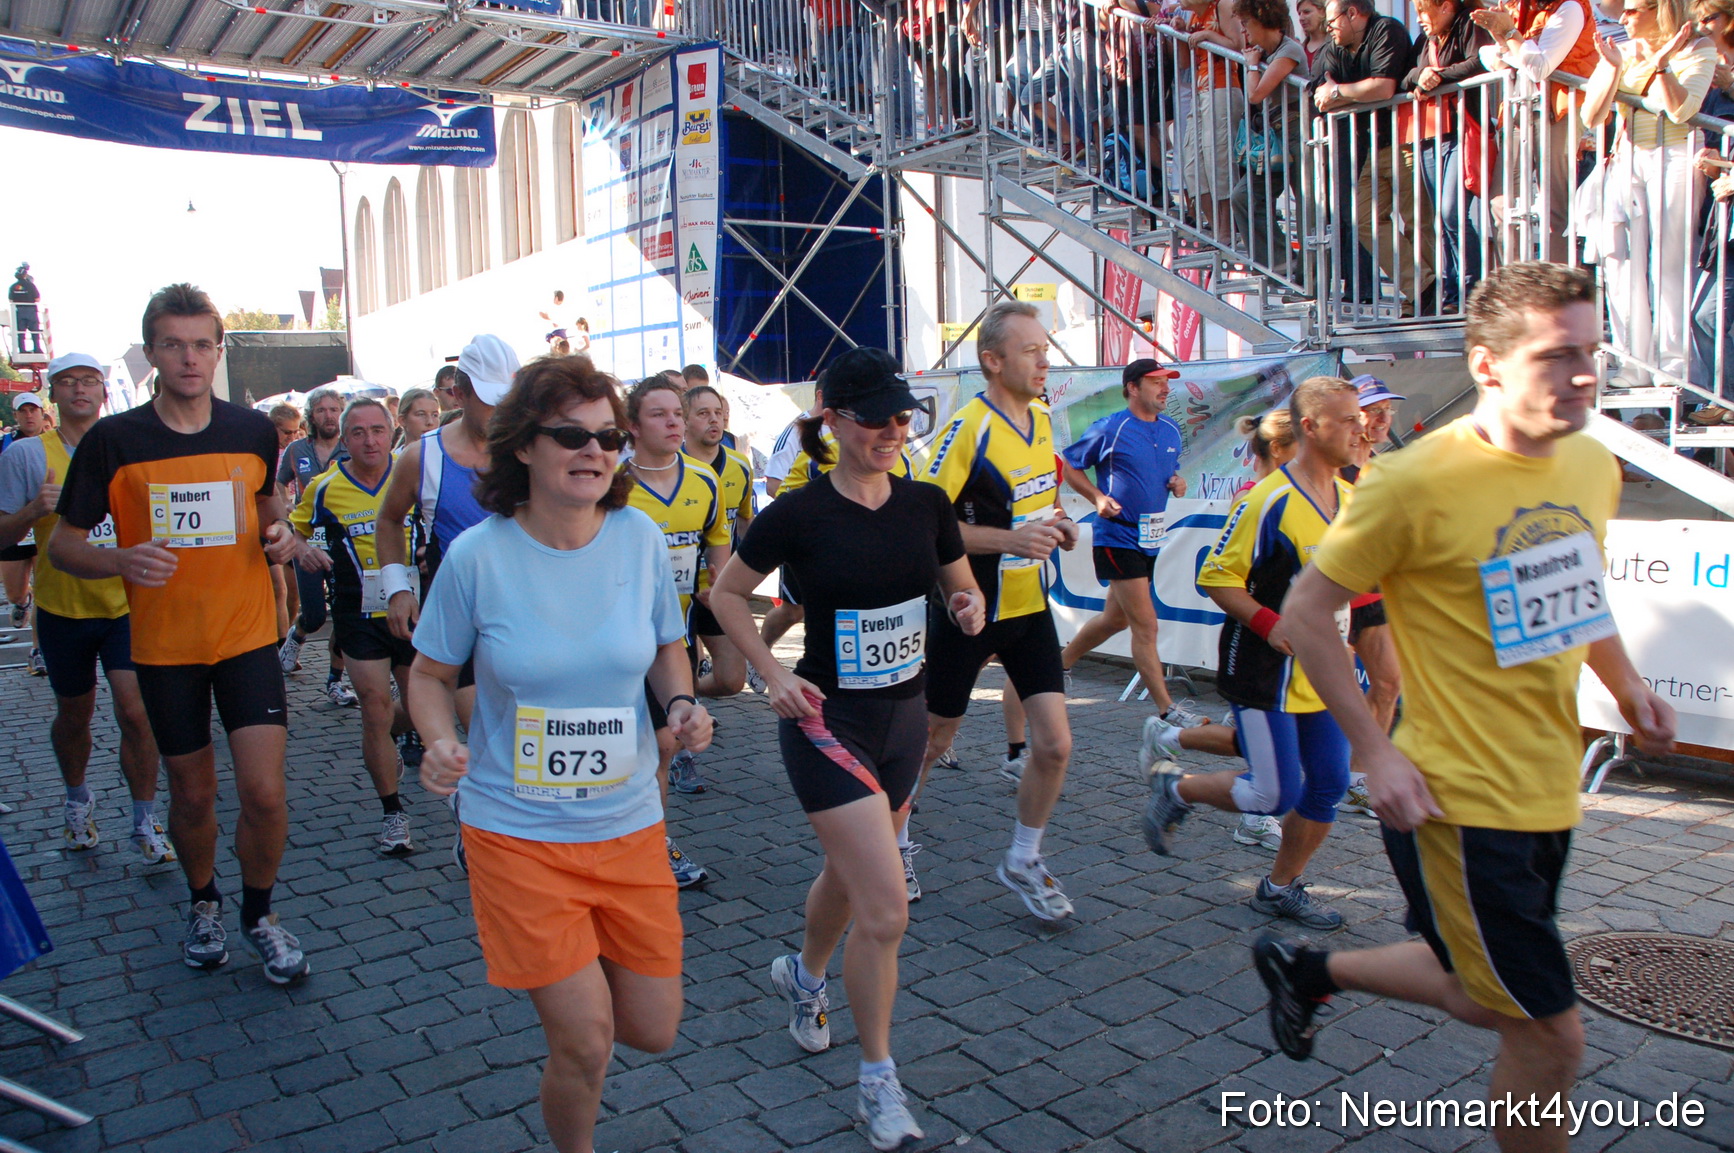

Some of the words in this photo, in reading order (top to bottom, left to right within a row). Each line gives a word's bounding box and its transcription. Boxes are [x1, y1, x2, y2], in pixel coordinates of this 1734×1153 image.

[183, 92, 323, 142] ZIEL
[1012, 471, 1058, 502] BOCK
[170, 490, 212, 503] Hubert
[155, 508, 164, 518] C
[173, 511, 202, 530] 70
[343, 509, 375, 522] TEAM
[674, 568, 690, 582] 21
[1514, 549, 1583, 585] Manfred
[1602, 552, 1670, 584] ute
[1494, 599, 1510, 615] C
[1524, 580, 1601, 628] 2773
[861, 614, 904, 634] Evelyn
[842, 641, 853, 654] C
[865, 631, 922, 667] 3055
[547, 718, 623, 736] Elisabeth
[522, 742, 535, 757] C
[548, 750, 608, 776] 673
